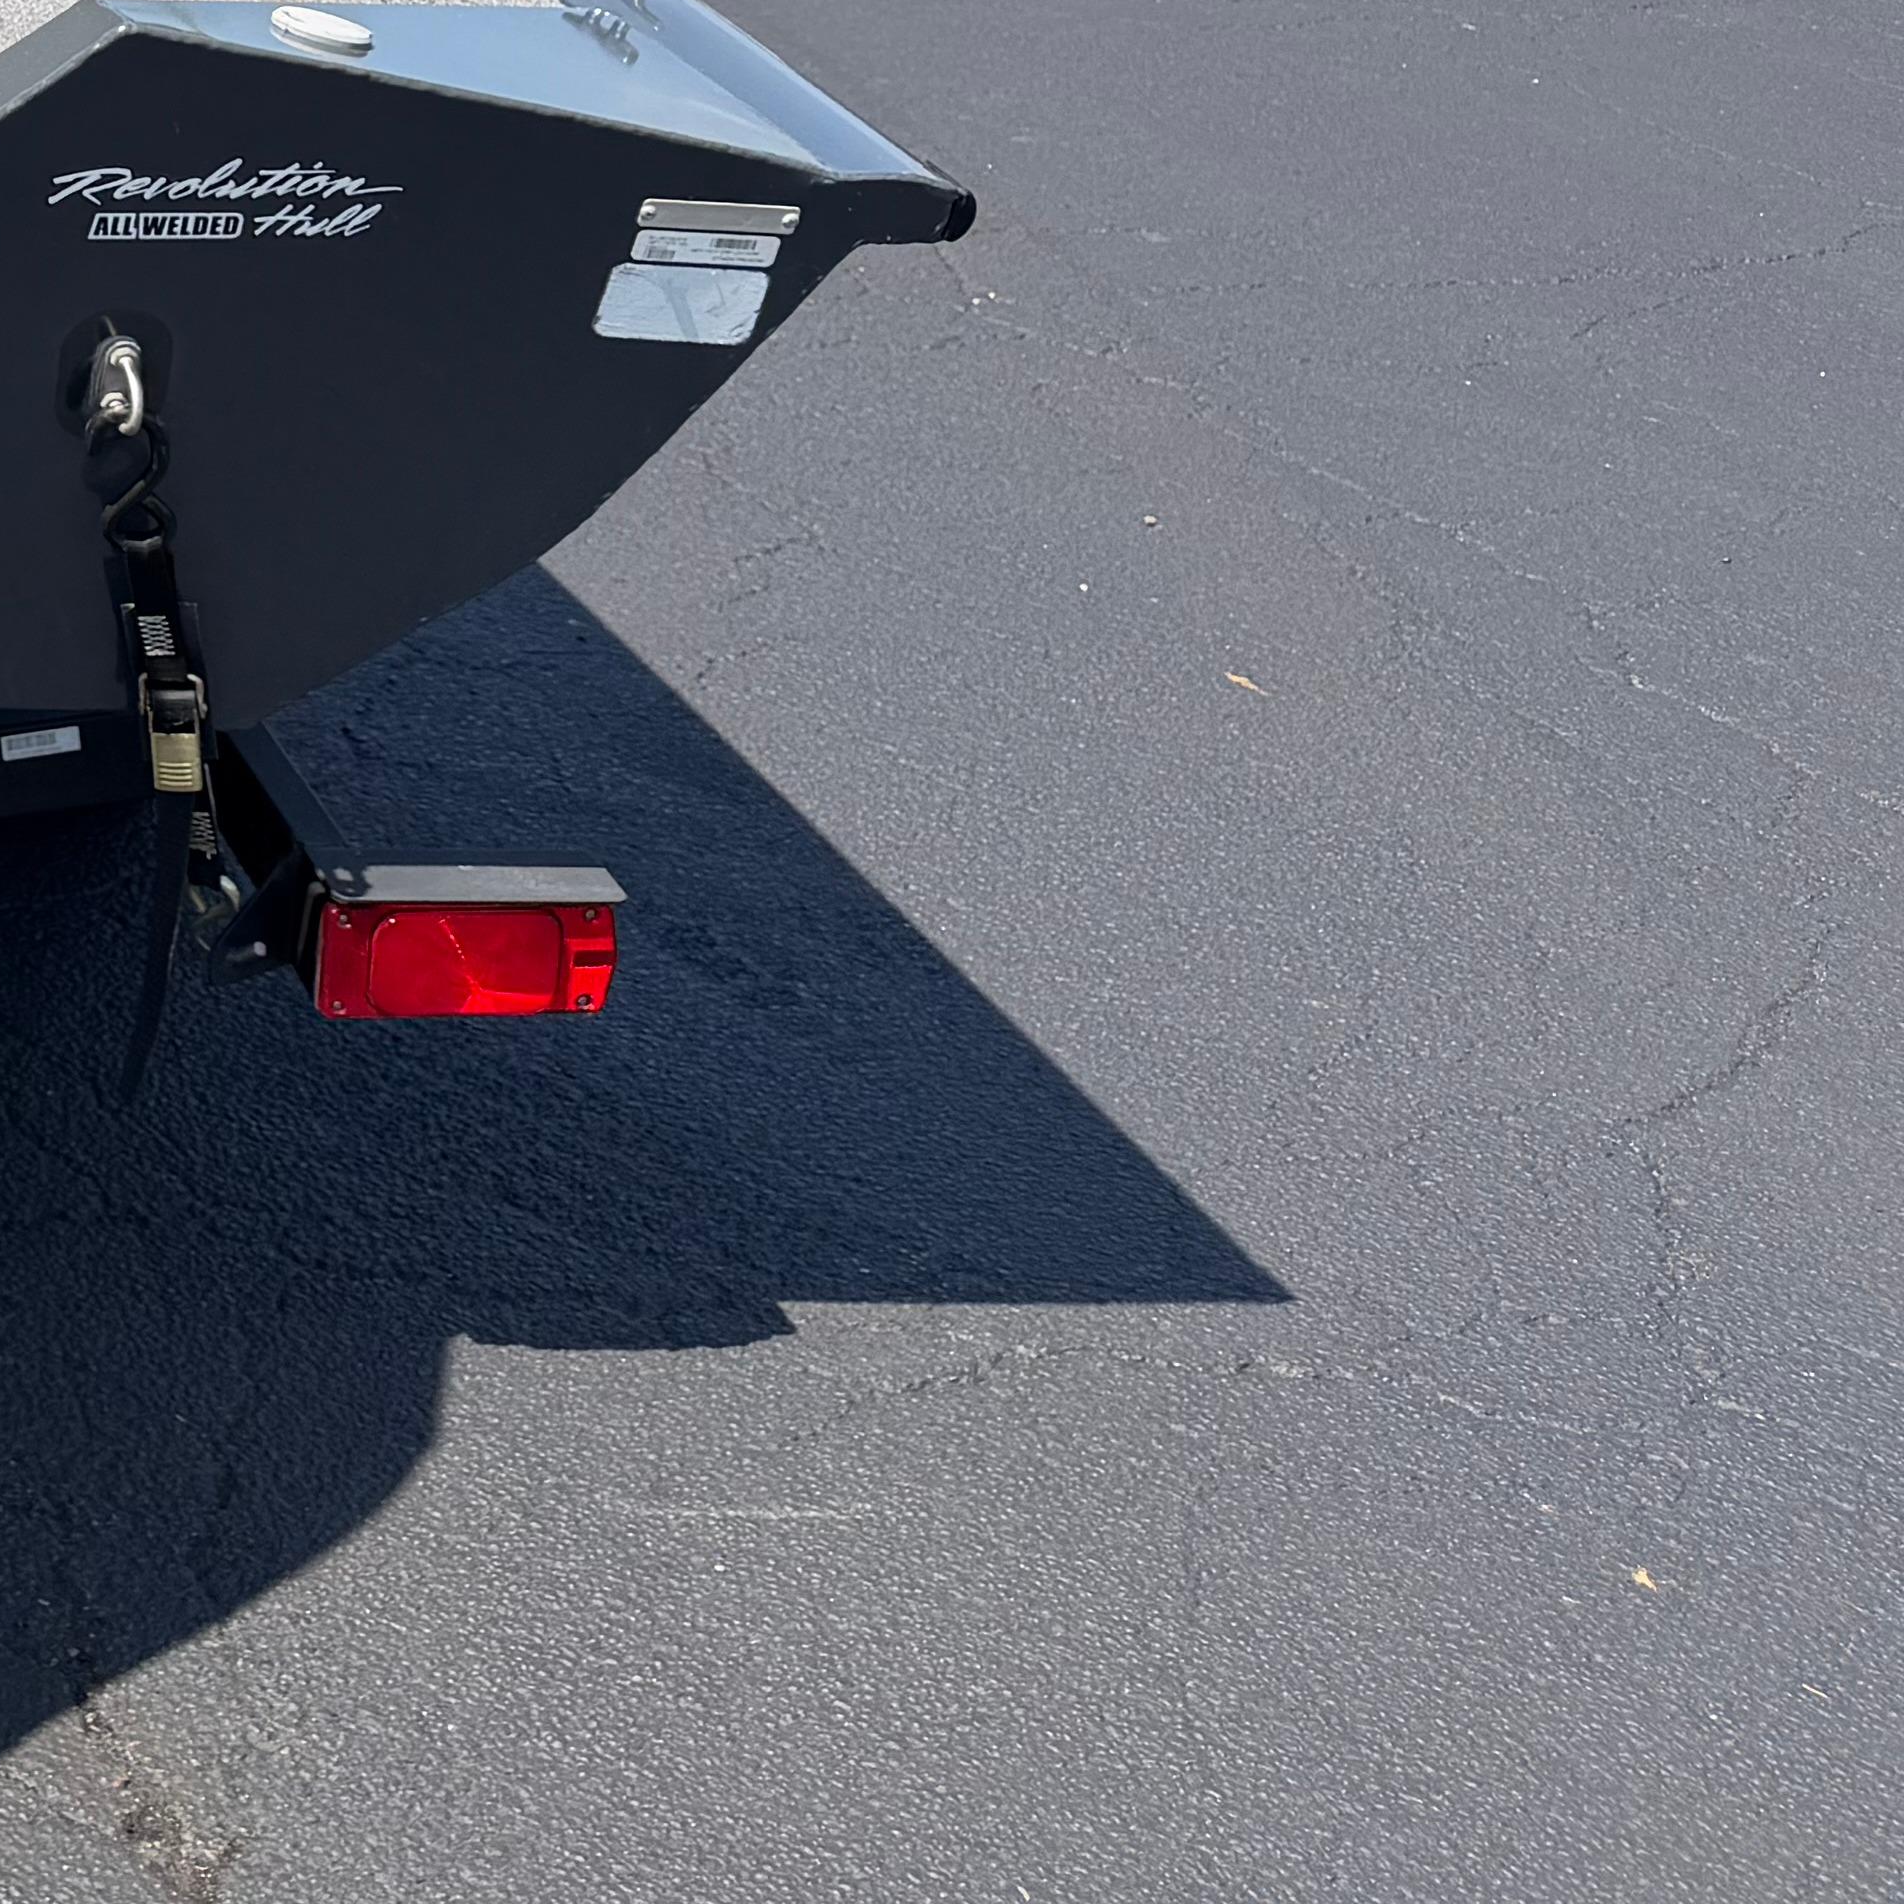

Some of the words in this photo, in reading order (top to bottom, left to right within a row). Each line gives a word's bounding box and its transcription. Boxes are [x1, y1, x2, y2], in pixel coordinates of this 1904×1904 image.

[47, 157, 404, 206] Revolution
[92, 215, 135, 237] ALL
[141, 215, 241, 237] WELDED
[253, 203, 384, 237] Hull
